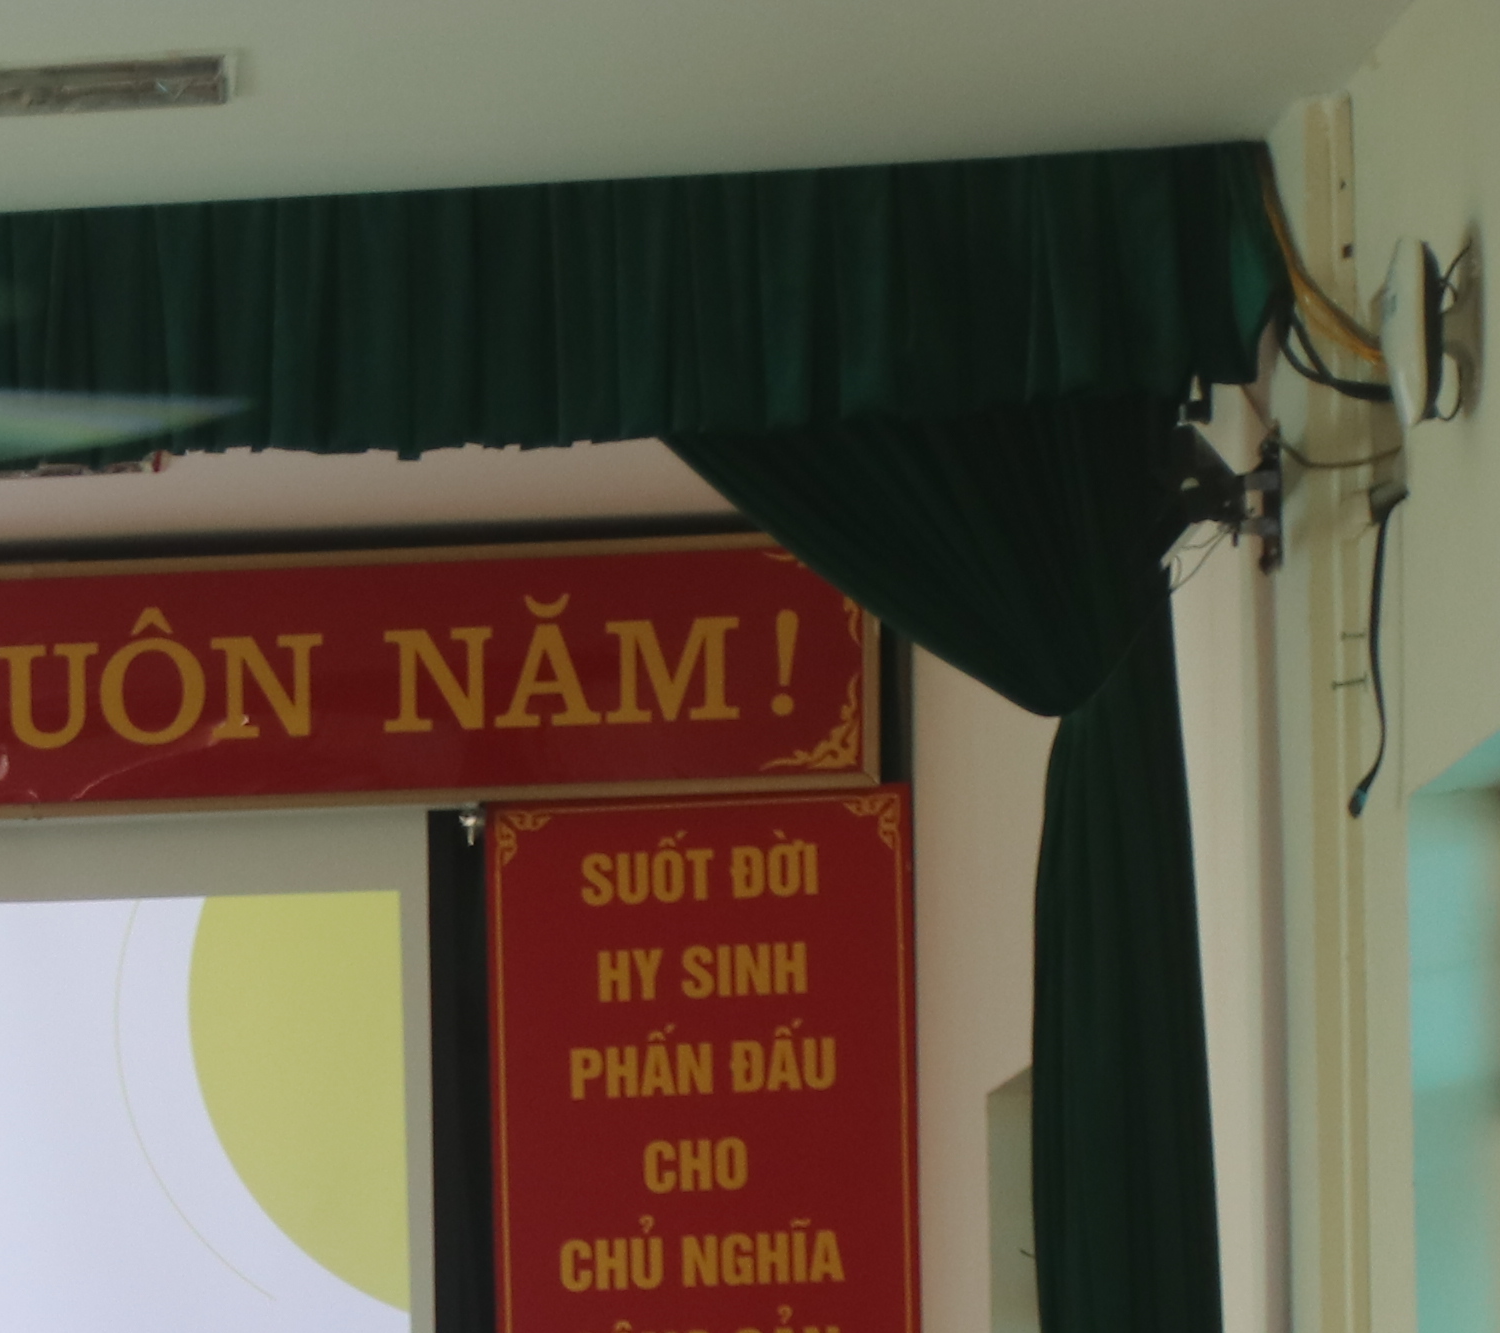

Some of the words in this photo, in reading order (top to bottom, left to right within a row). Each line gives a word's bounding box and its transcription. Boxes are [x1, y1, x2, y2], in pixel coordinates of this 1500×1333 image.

[581, 832, 714, 906] SUỐT
[730, 831, 818, 898] ĐỜI
[598, 949, 662, 1002] HY
[682, 942, 807, 998] SINH
[570, 1025, 712, 1099] PHẤN
[730, 1020, 836, 1092] ĐẤU
[644, 1137, 747, 1193] CHO
[560, 1216, 663, 1292] CHỦ
[682, 1219, 844, 1287] NGHĨA
